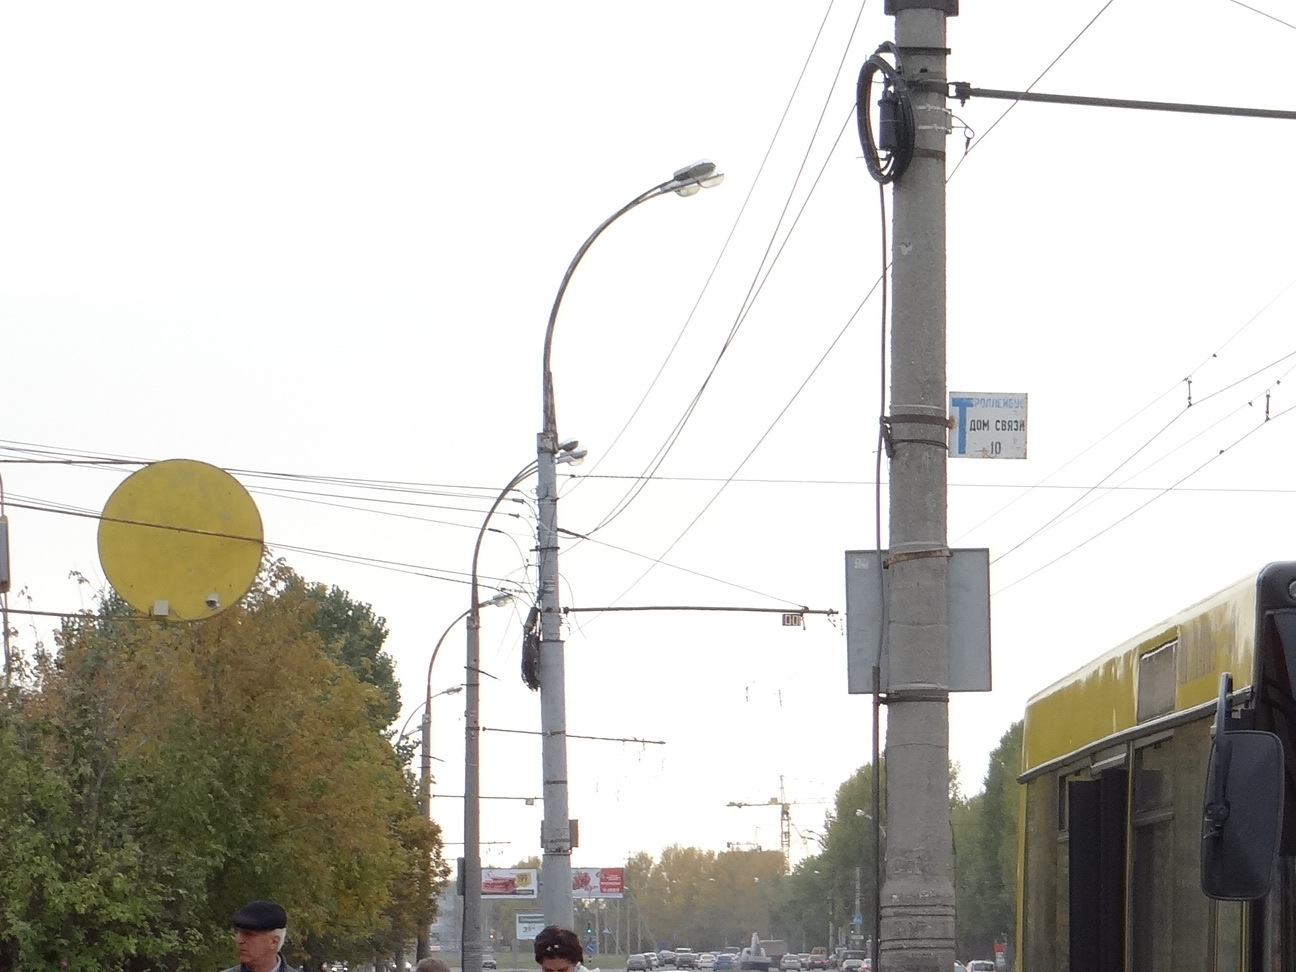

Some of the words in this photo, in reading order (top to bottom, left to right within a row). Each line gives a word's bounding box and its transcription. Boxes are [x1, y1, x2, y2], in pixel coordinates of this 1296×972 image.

[969, 419, 990, 432] ДОМ
[995, 419, 1026, 432] СВЯЗИ
[990, 441, 1002, 455] 10
